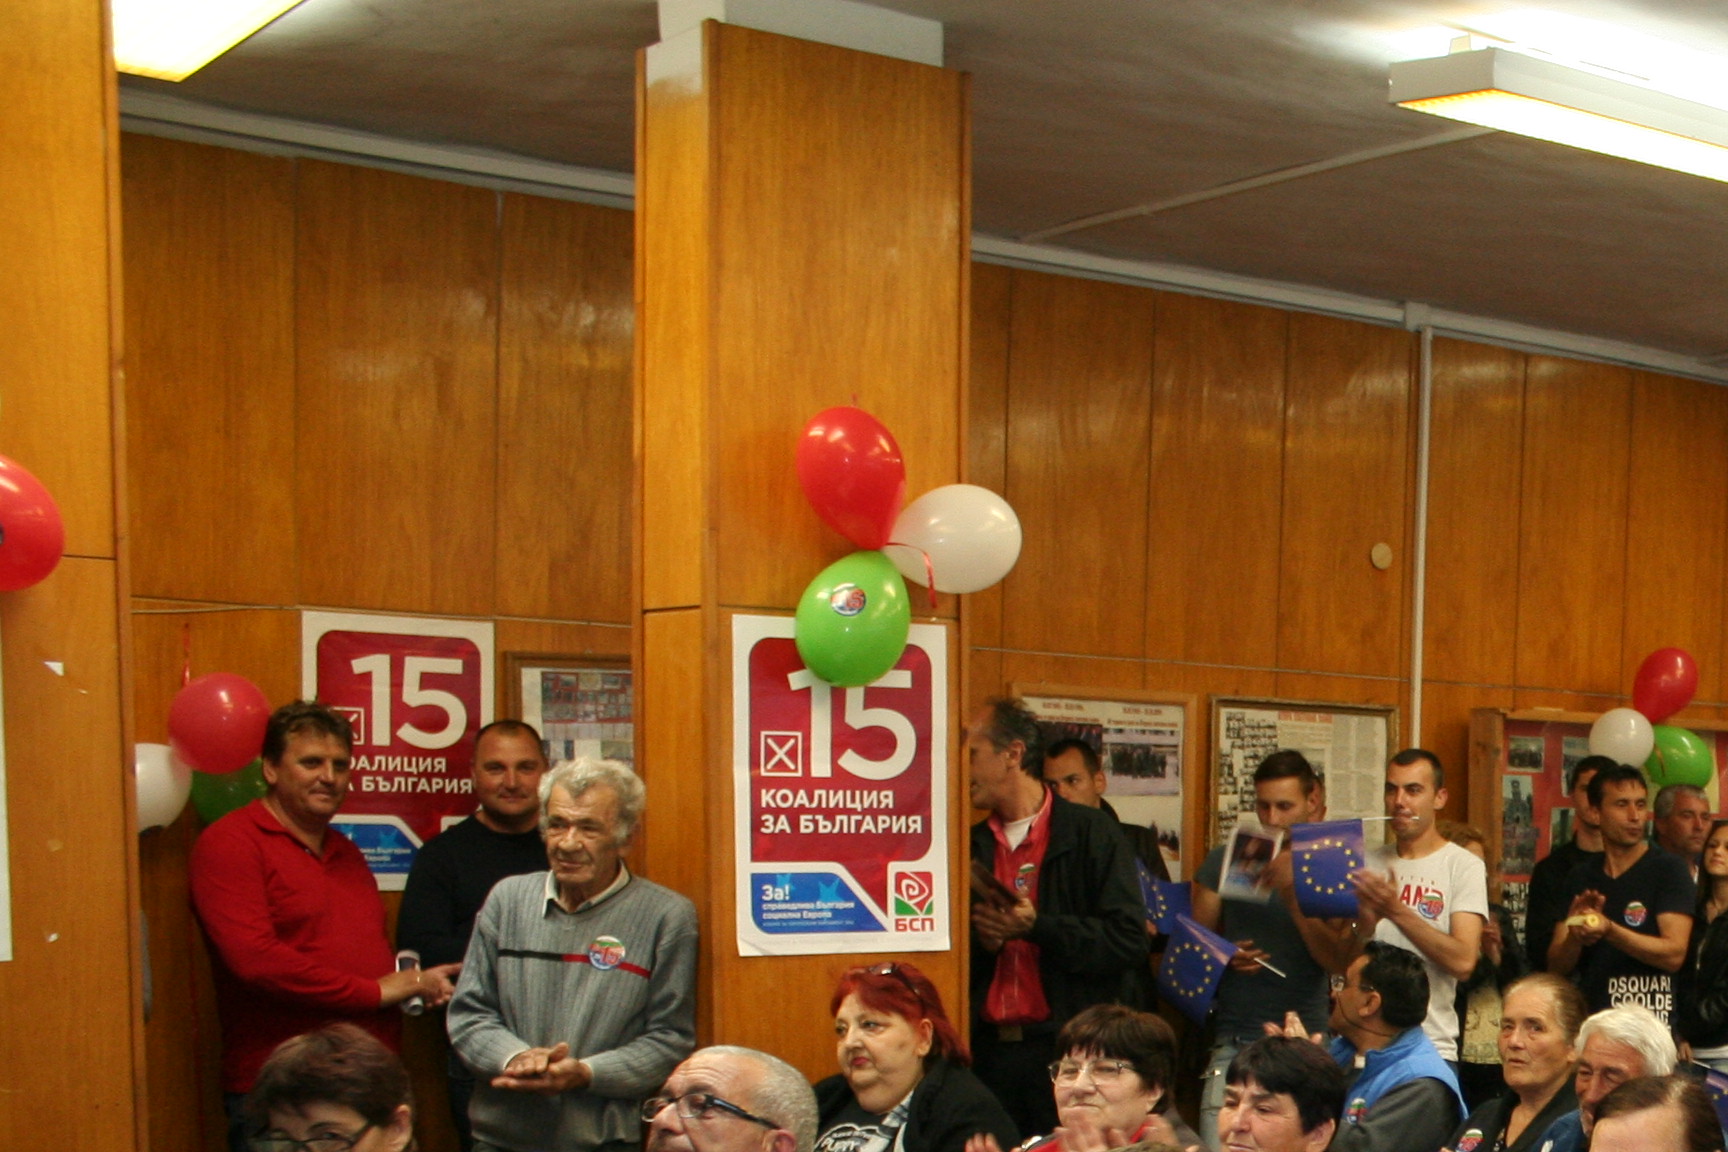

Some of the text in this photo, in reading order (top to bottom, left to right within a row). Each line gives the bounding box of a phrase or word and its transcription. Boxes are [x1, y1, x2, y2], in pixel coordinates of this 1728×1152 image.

[351, 654, 467, 749] 15
[787, 669, 917, 781] 15
[362, 776, 473, 794] БЪЛГАРИЯ
[761, 789, 894, 811] КОАЛИЦИЯ
[760, 815, 923, 834] ЗА БЪЛГАРИЯ
[762, 884, 790, 901] За!
[895, 917, 935, 932] БСП
